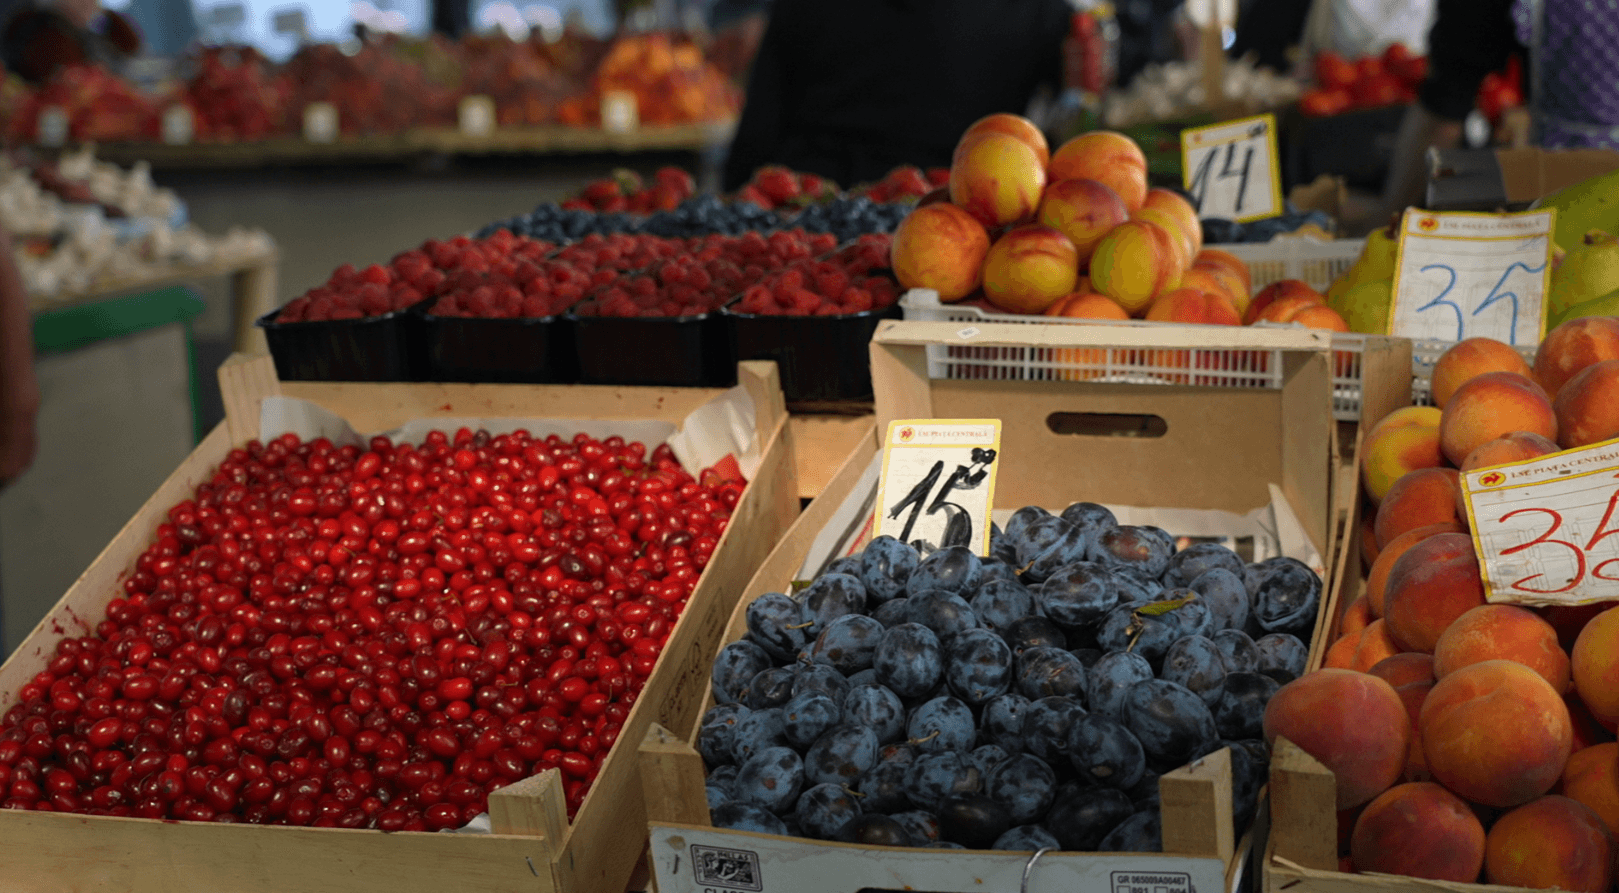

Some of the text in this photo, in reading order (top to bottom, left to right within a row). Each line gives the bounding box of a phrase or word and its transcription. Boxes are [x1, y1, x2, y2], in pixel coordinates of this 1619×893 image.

[1189, 143, 1254, 213] 14
[887, 460, 988, 553] 15
[1117, 875, 1130, 884] GR
